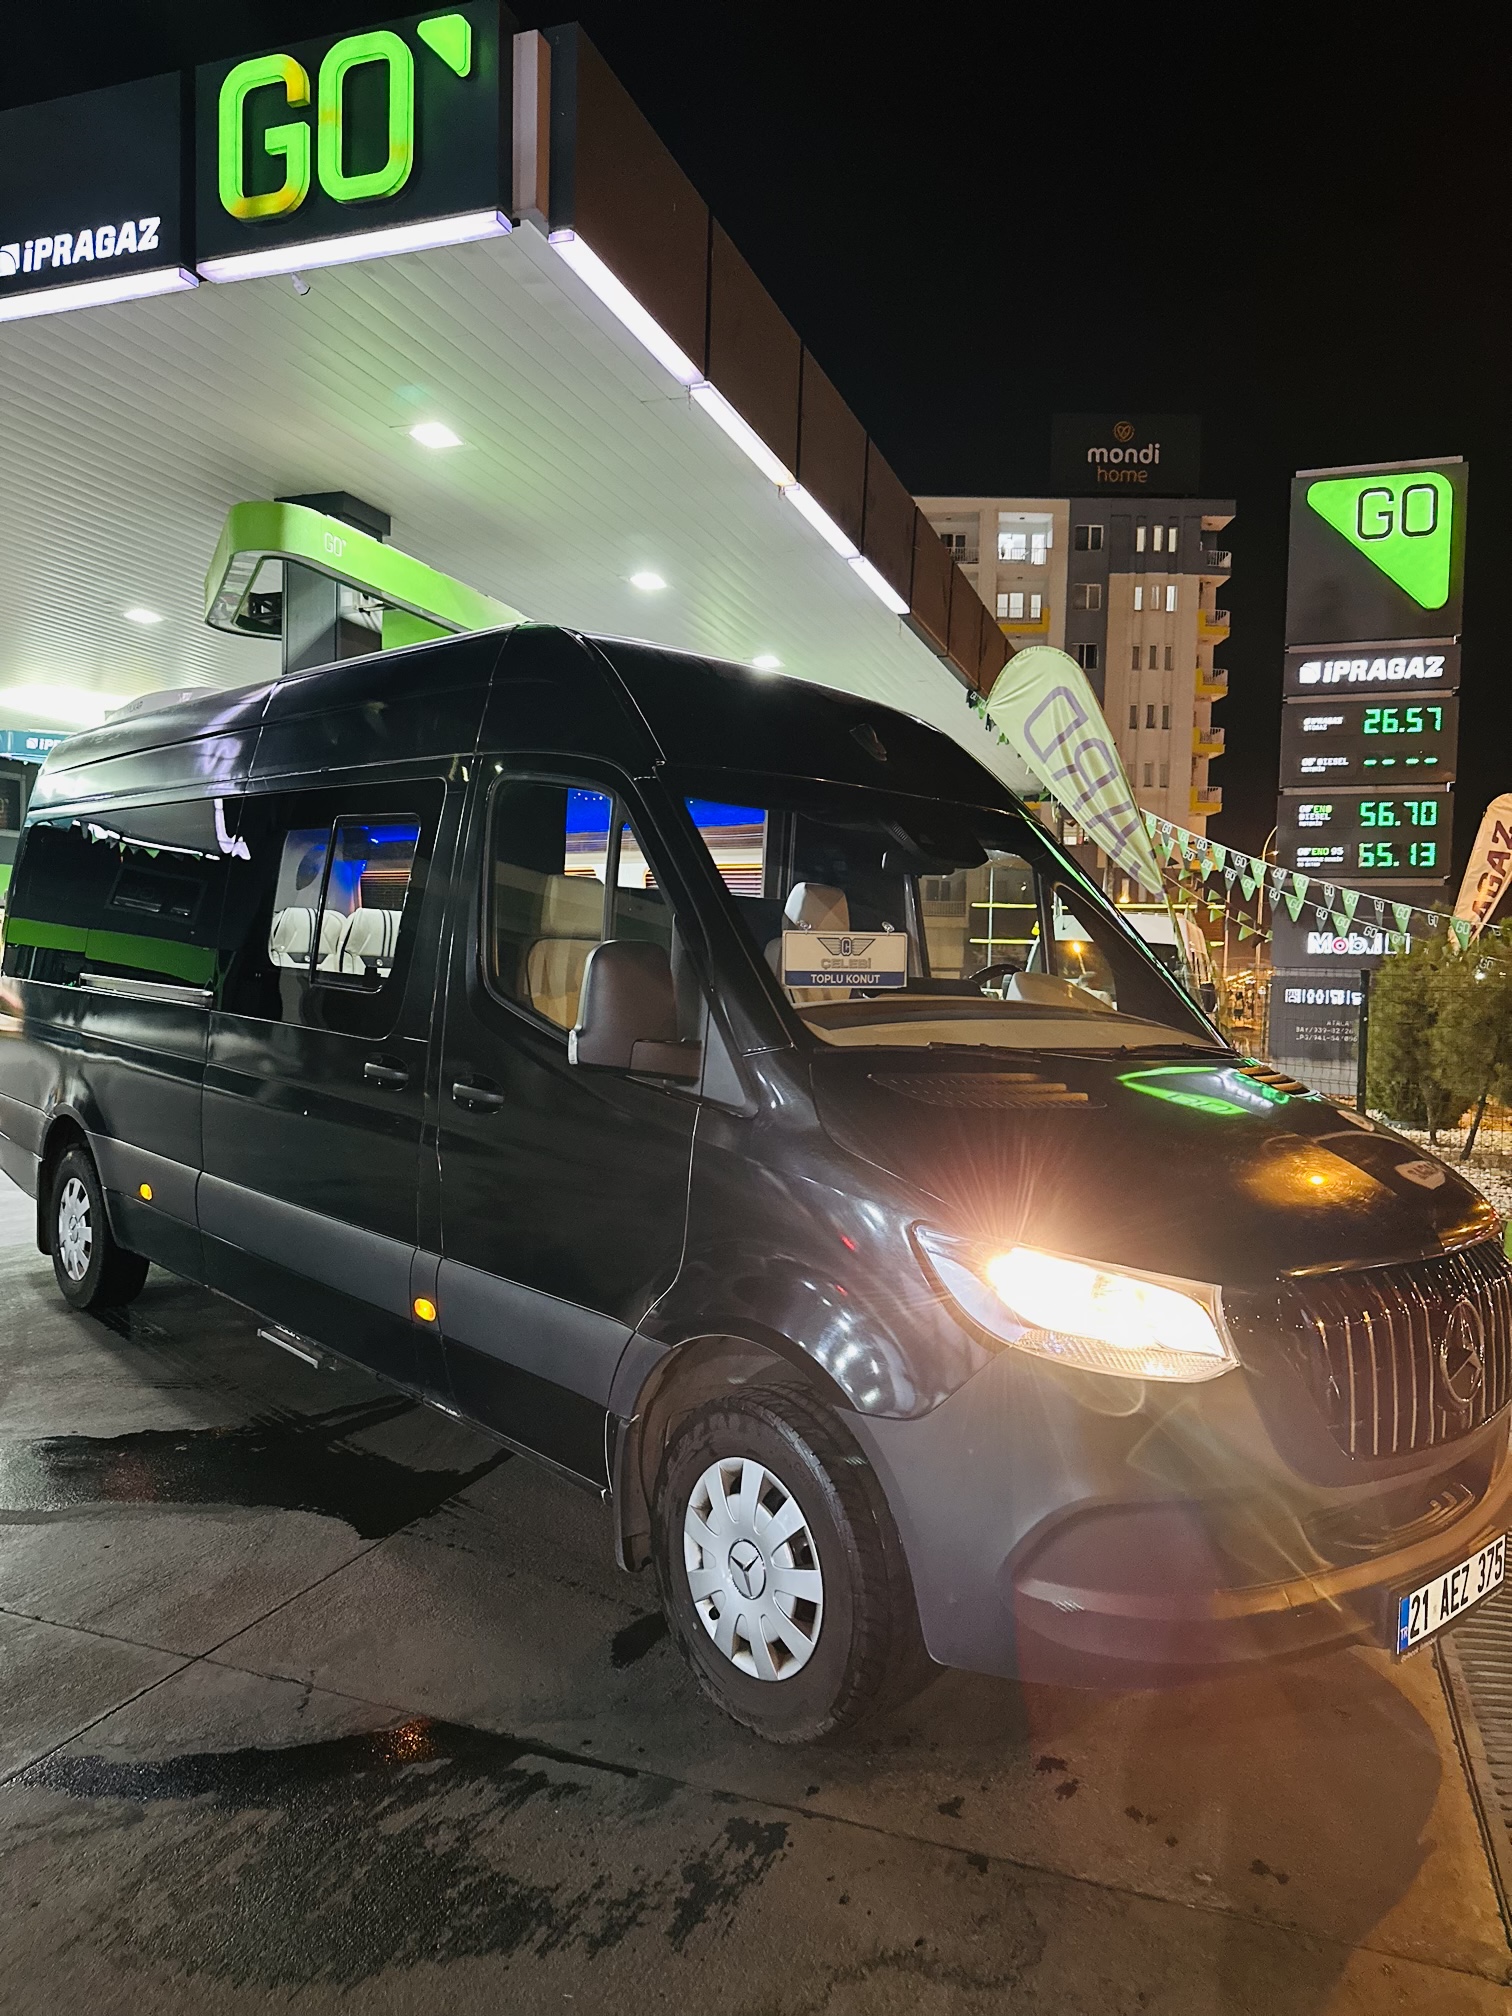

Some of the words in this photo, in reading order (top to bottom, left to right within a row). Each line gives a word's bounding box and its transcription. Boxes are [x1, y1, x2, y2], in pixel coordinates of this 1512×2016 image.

[219, 30, 415, 221] GO
[1087, 444, 1160, 464] mondi
[1097, 466, 1148, 484] home
[1357, 484, 1438, 540] GO
[324, 532, 342, 557] GO
[1363, 707, 1442, 734] 26.57
[1360, 801, 1438, 827] 56.70
[1316, 907, 1328, 920] GO
[1396, 906, 1409, 920] GO
[1456, 921, 1470, 934] GO
[811, 974, 843, 984] TOPLU
[846, 974, 880, 984] KONUT
[1400, 1626, 1408, 1641] TR
[1410, 1588, 1428, 1639] 21
[1440, 1564, 1470, 1621] AEZ
[1478, 1541, 1503, 1593] 375
